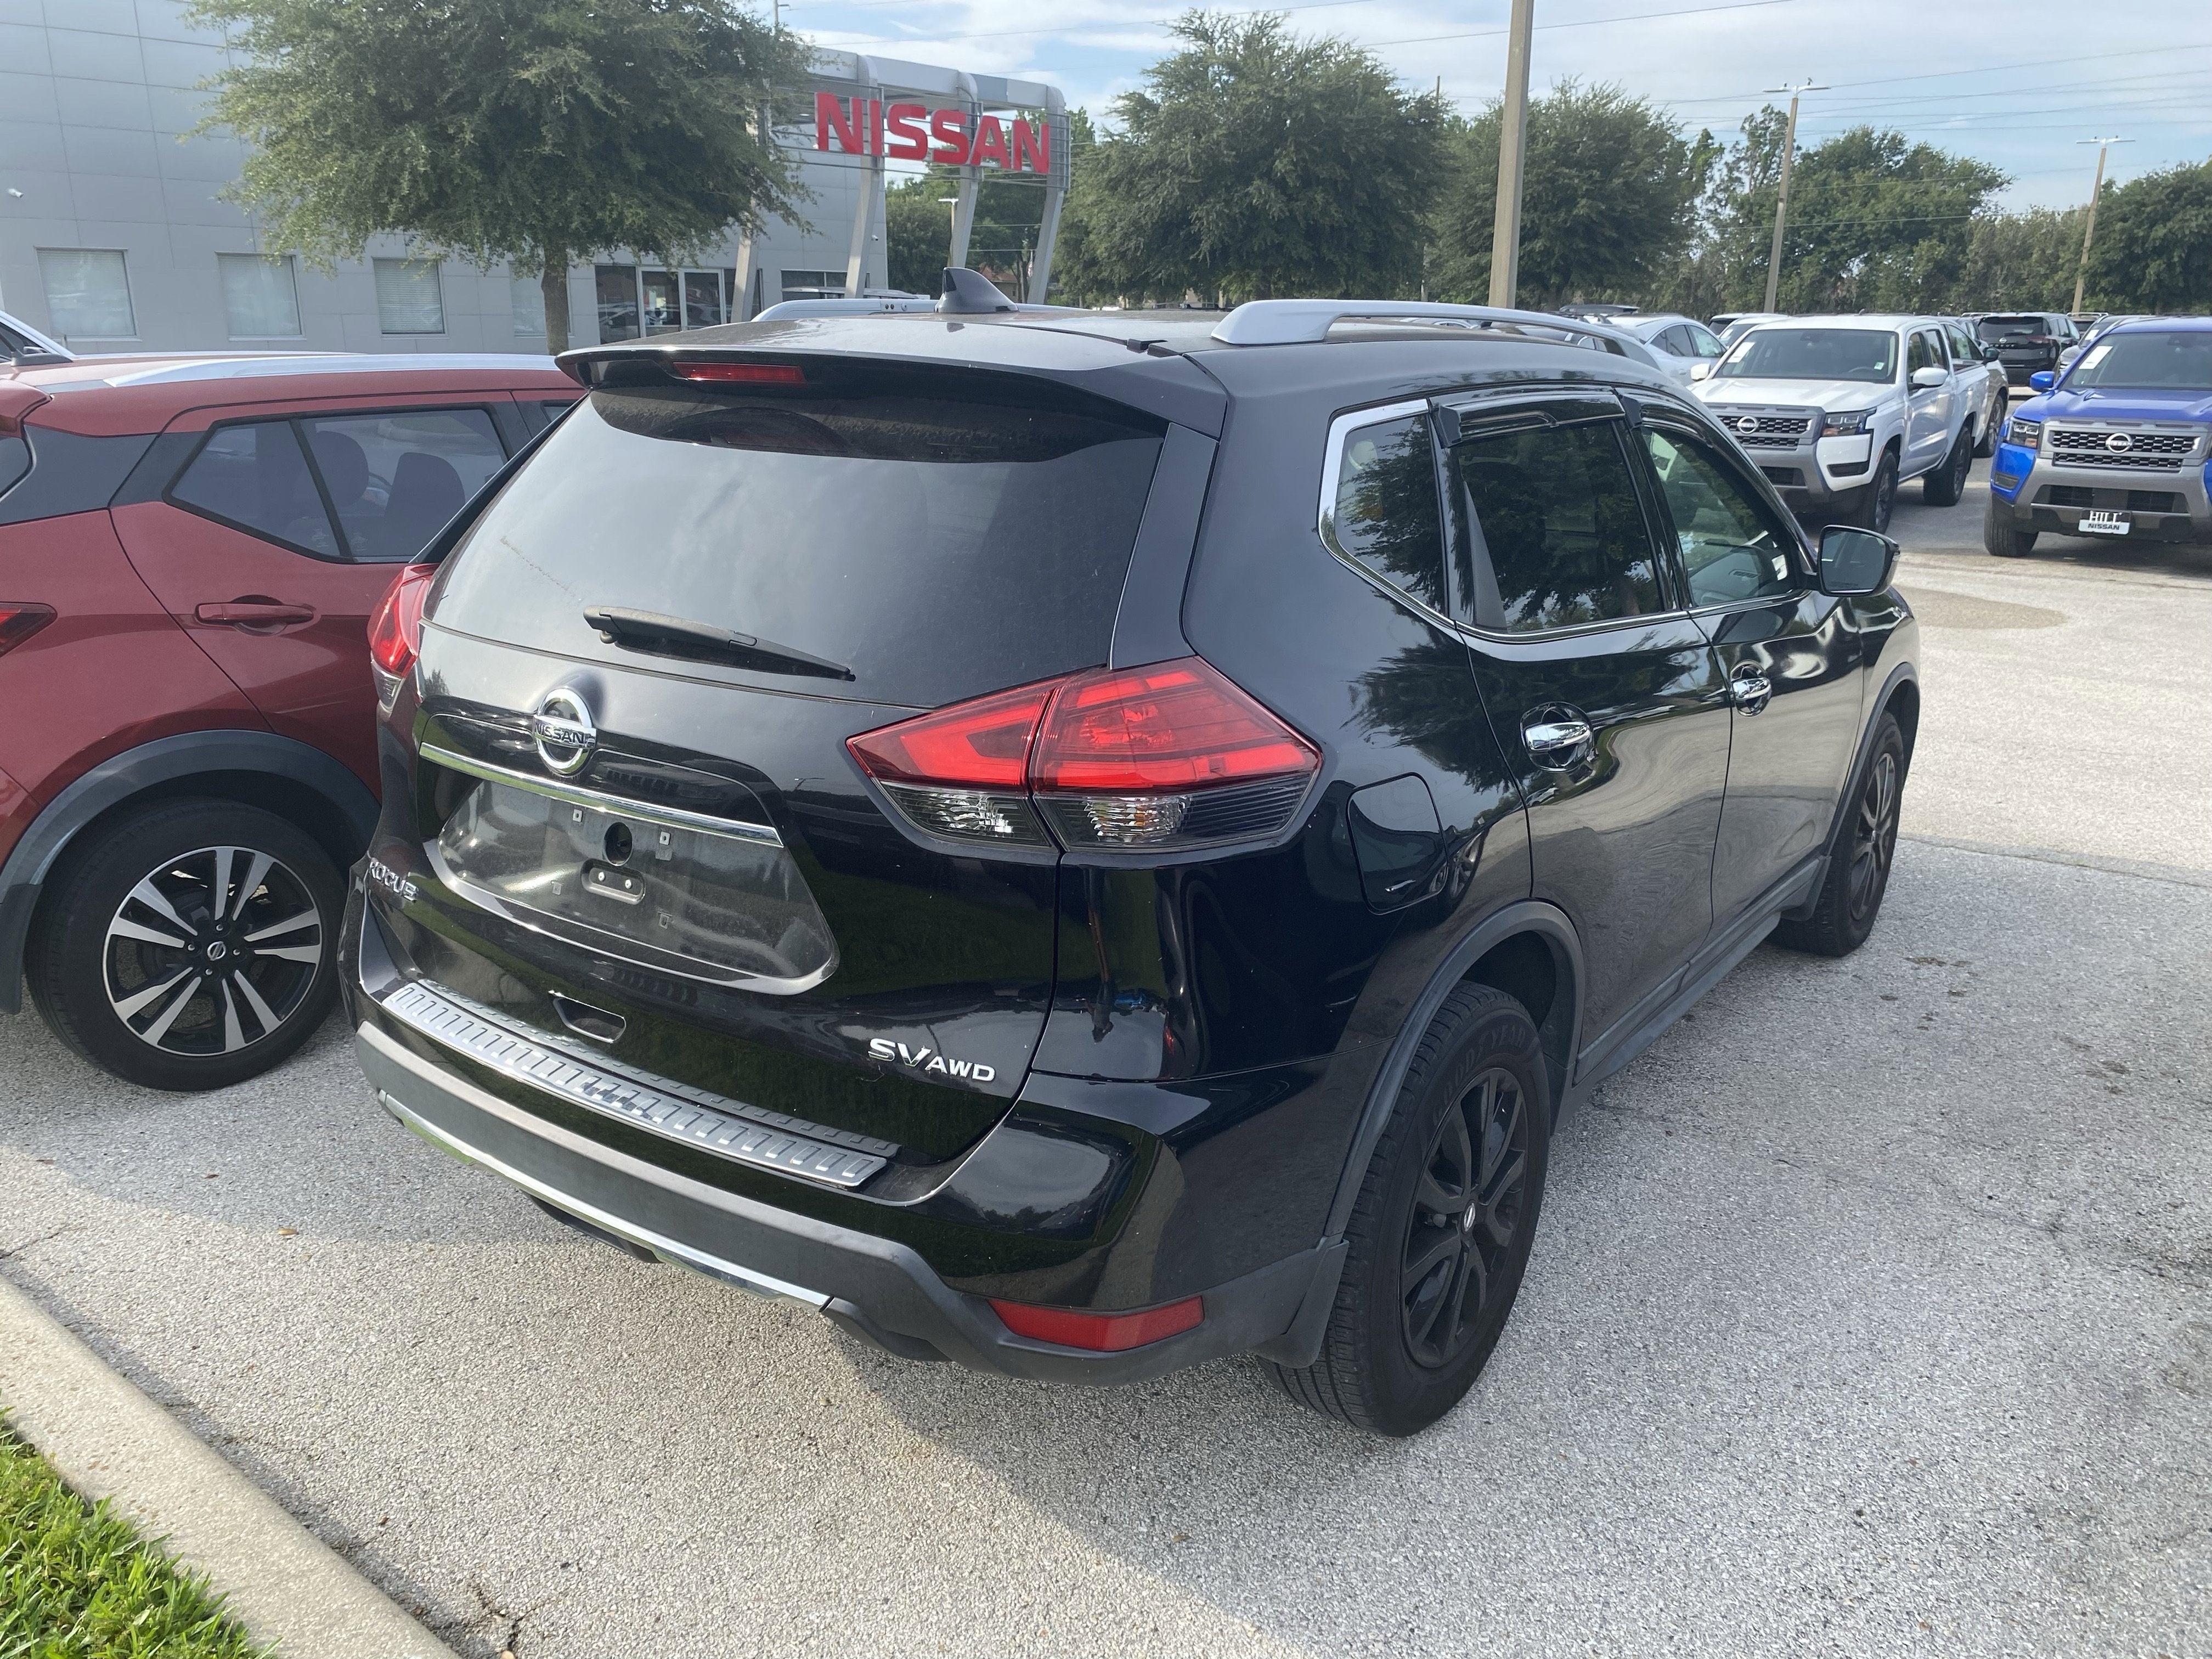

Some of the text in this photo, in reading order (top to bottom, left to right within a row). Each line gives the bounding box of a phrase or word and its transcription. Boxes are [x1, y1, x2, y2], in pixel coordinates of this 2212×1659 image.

[815, 92, 1050, 174] NISSAN
[2089, 511, 2121, 524] HILL
[535, 723, 584, 744] NISSAN
[868, 1038, 996, 1082] SV AWD
